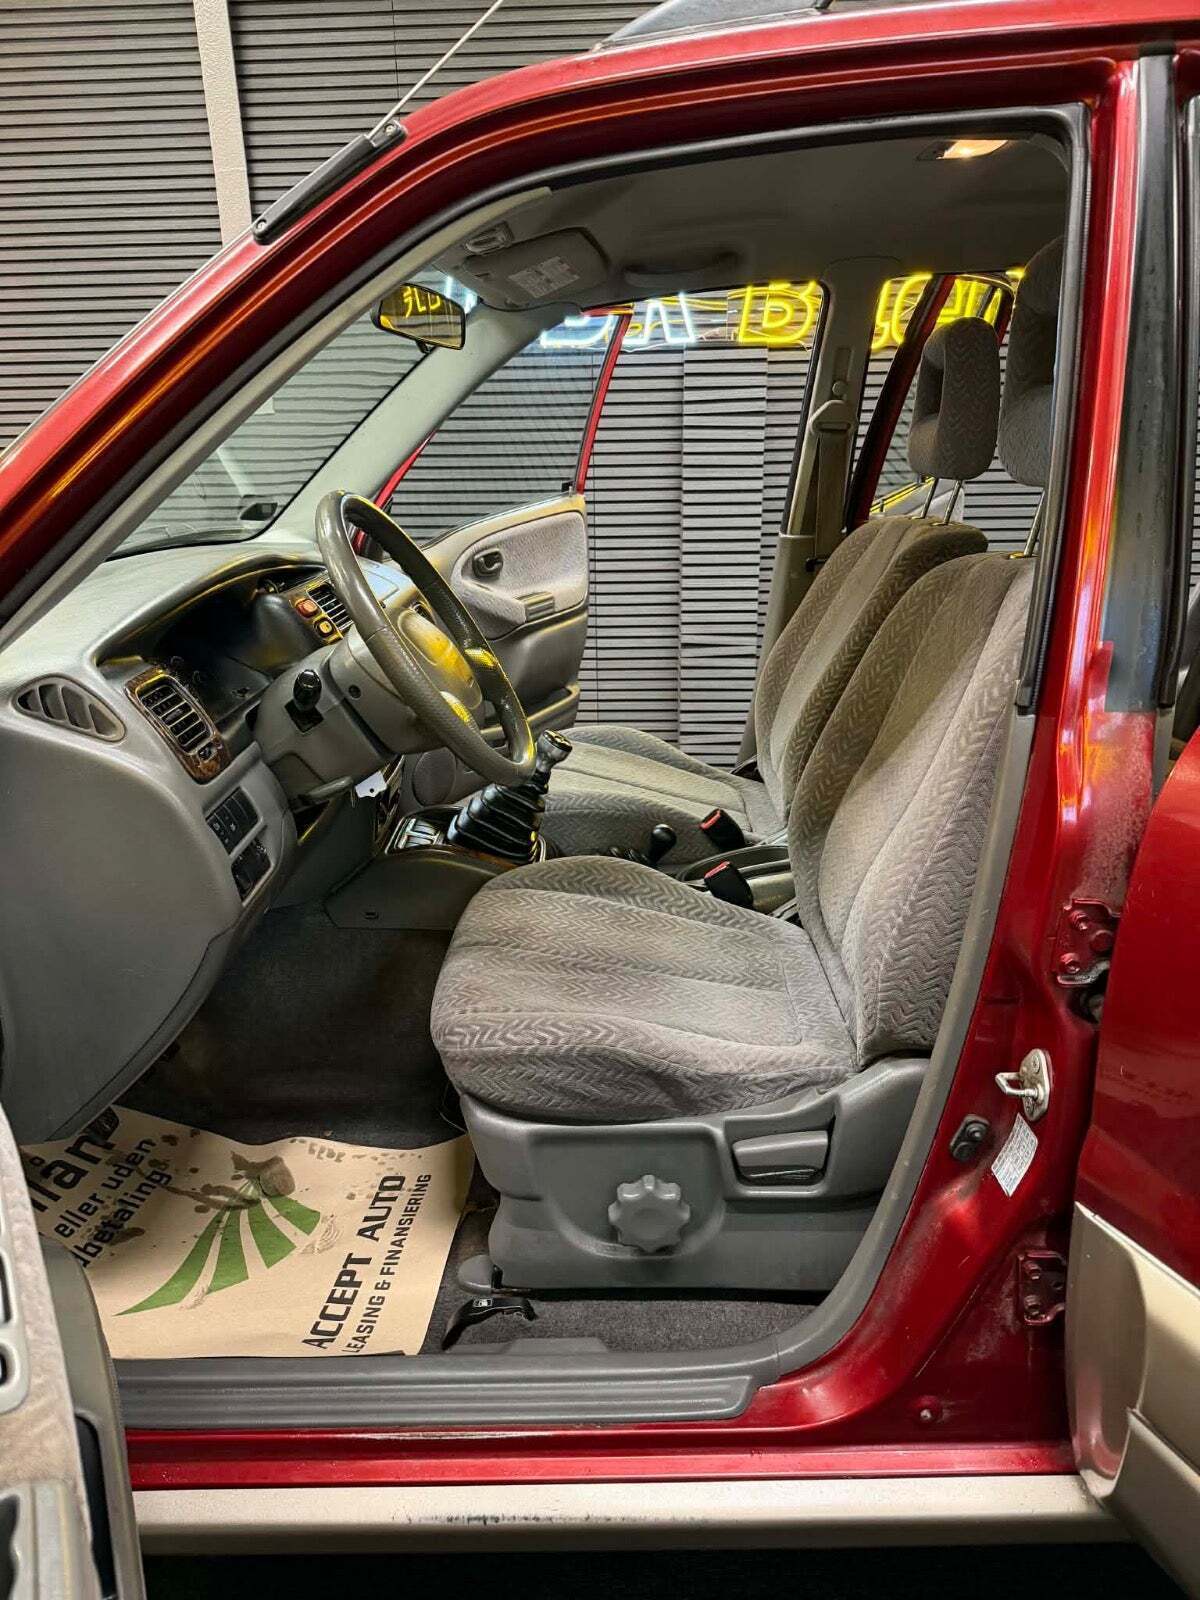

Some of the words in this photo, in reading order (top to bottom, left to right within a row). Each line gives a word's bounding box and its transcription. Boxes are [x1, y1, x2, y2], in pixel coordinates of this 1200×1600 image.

[54, 1193, 104, 1238] eller
[101, 1138, 156, 1189] uden
[380, 1174, 432, 1276] FINANSIERING
[302, 1252, 372, 1349] ACCEPT
[356, 1175, 406, 1242] AUTO
[374, 1280, 391, 1291] &
[342, 1296, 385, 1353] LEASING
